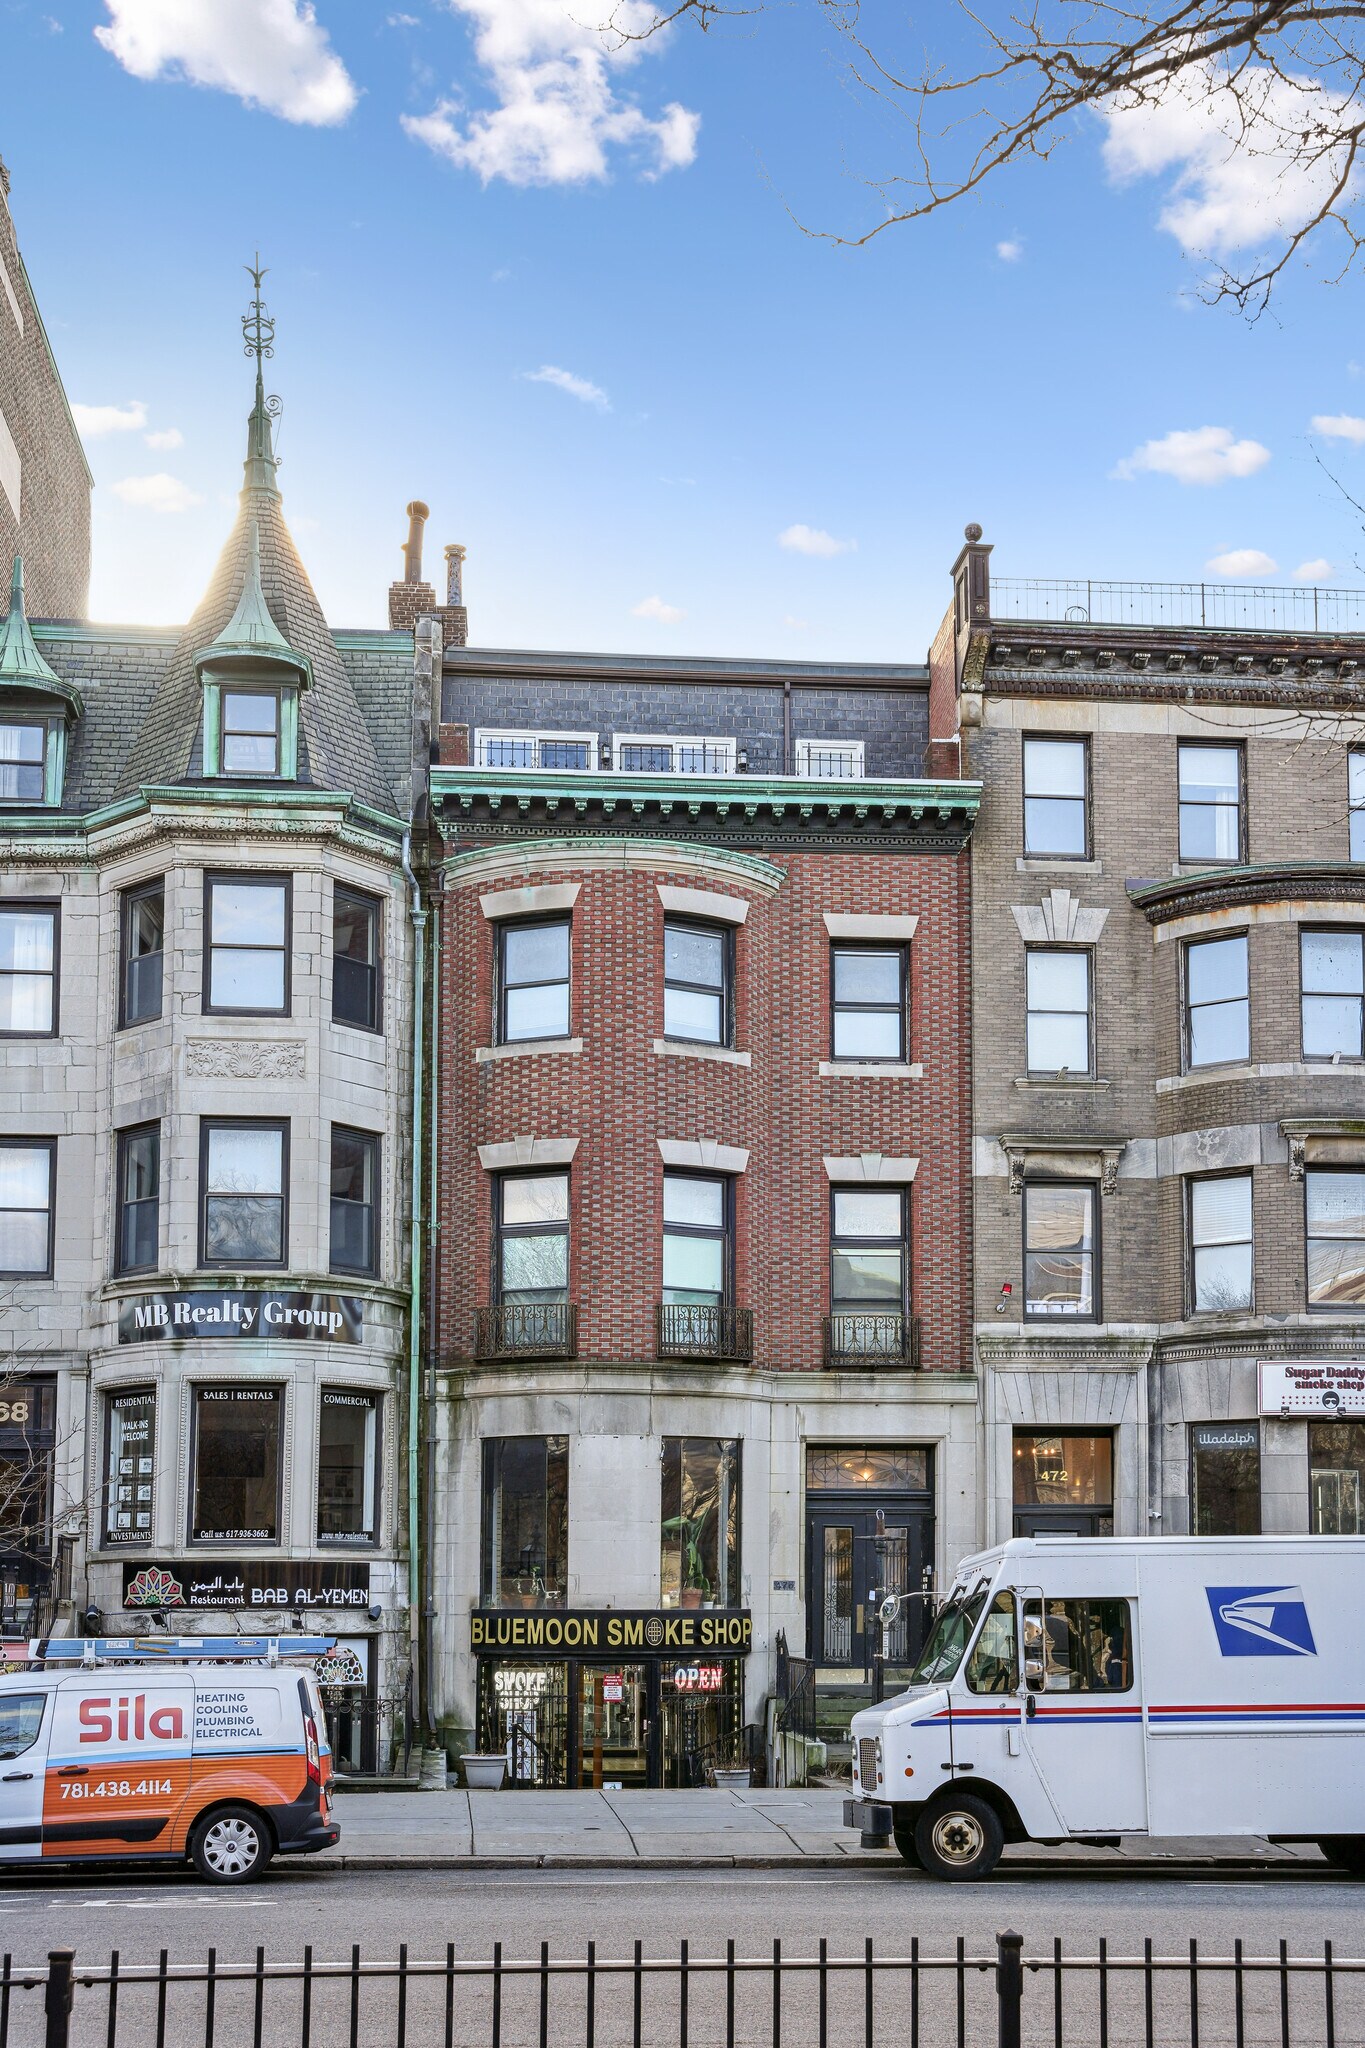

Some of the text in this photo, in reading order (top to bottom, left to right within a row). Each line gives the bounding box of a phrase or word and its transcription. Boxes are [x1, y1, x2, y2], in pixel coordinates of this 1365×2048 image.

[134, 1299, 343, 1335] MB Realty Group
[1285, 1366, 1325, 1380] Sugar
[1294, 1378, 1365, 1392] smoke shop
[115, 1395, 156, 1408] RESIDENTIAL
[203, 1391, 228, 1400] SALES
[237, 1391, 274, 1400] RENTALS
[323, 1395, 371, 1407] COMMERCIAL
[121, 1420, 149, 1431] WALK-INS
[120, 1431, 149, 1442] WELCOME
[1199, 1432, 1255, 1446] illadelph
[1041, 1470, 1068, 1481] 472
[111, 1531, 152, 1541] INVESTMENTS
[200, 1530, 213, 1538] Call
[190, 1576, 245, 1593] باب اليمن
[190, 1595, 245, 1605] Restaurant
[251, 1588, 369, 1604] BAB AL-YEMEN
[471, 1618, 598, 1645] BLUEMOON
[701, 1618, 752, 1645] SHOP
[494, 1671, 547, 1691] SMOKE
[675, 1668, 722, 1689] OPEN
[196, 1693, 246, 1703] HEATING
[196, 1704, 248, 1715] COOLING
[79, 1694, 183, 1743] Sila
[196, 1716, 254, 1727] PLUMBING
[196, 1727, 263, 1738] ELECTRICAL
[60, 1778, 172, 1799] 781.438.4114
